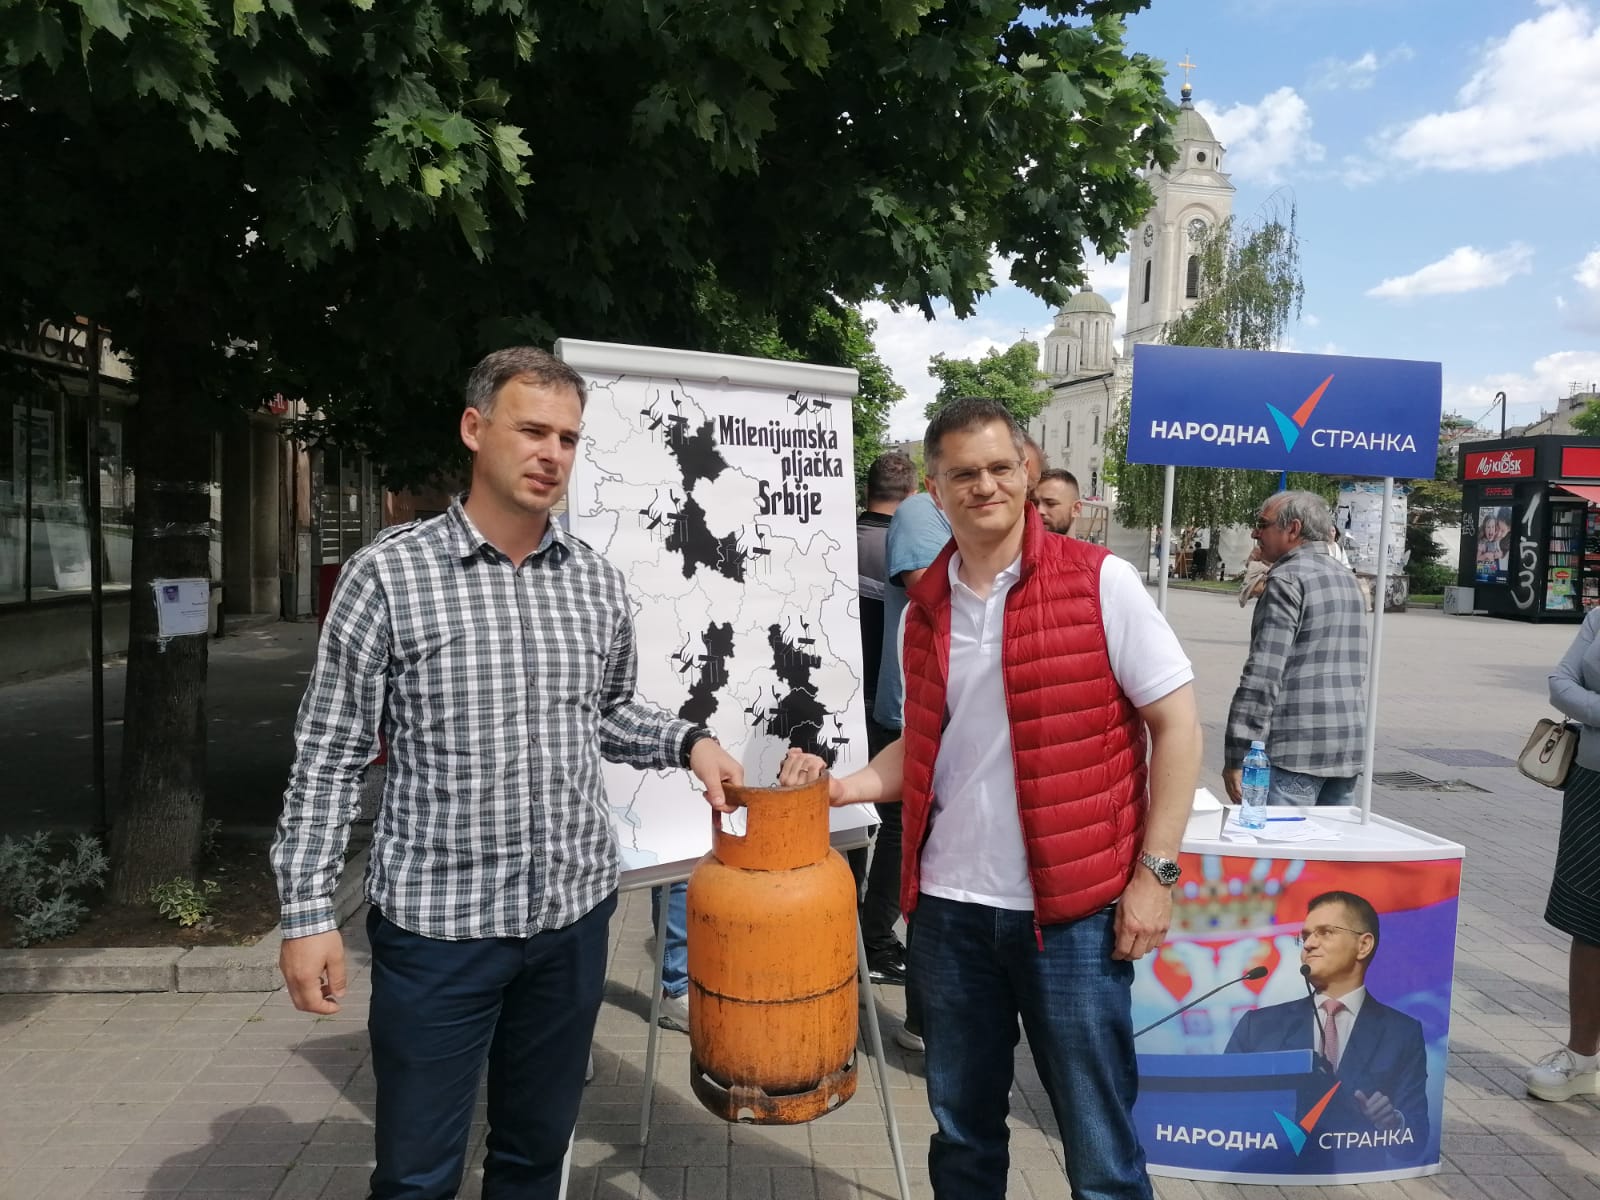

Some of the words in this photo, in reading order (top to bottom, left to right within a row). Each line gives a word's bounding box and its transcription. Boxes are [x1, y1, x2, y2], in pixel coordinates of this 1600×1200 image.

[719, 414, 838, 455] Milenijumska
[1150, 420, 1271, 447] НАРОДНА
[1311, 429, 1417, 453] СТРАНКА
[781, 448, 844, 484] pljačka
[758, 479, 823, 524] Srbije
[1156, 1123, 1279, 1151] НАРОДНА
[1318, 1128, 1415, 1150] СТРАНКА
